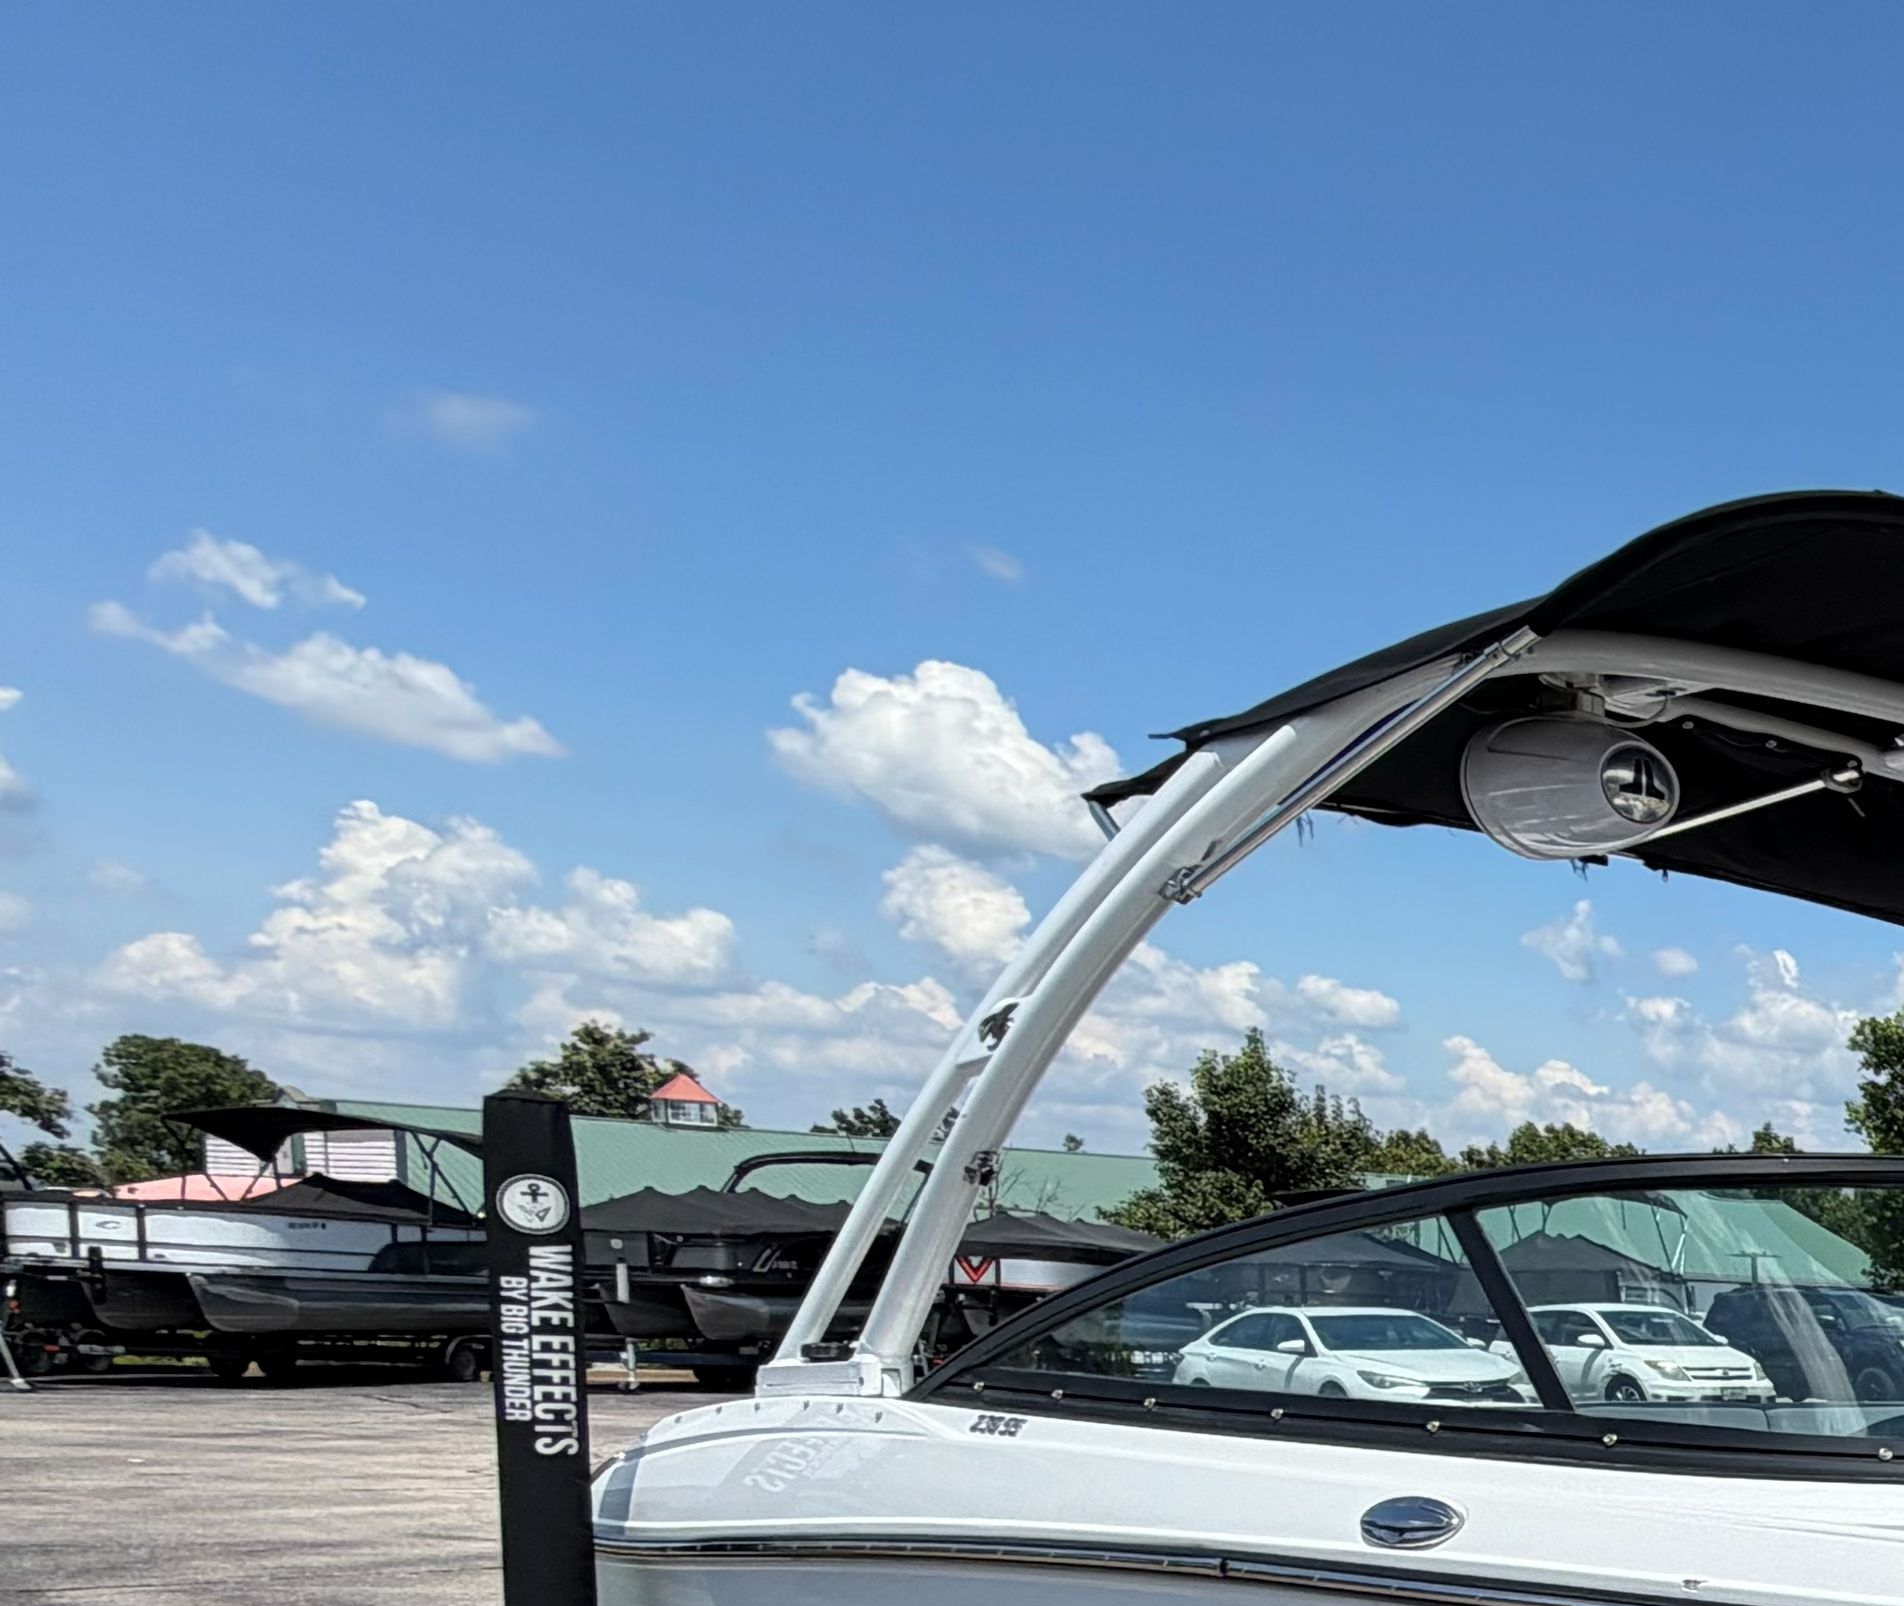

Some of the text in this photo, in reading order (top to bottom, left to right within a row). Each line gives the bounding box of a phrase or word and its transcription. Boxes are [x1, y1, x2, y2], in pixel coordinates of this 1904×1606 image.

[500, 1275, 533, 1422] BY BIG THUNDER
[529, 1245, 579, 1455] WAKE EFFECTS
